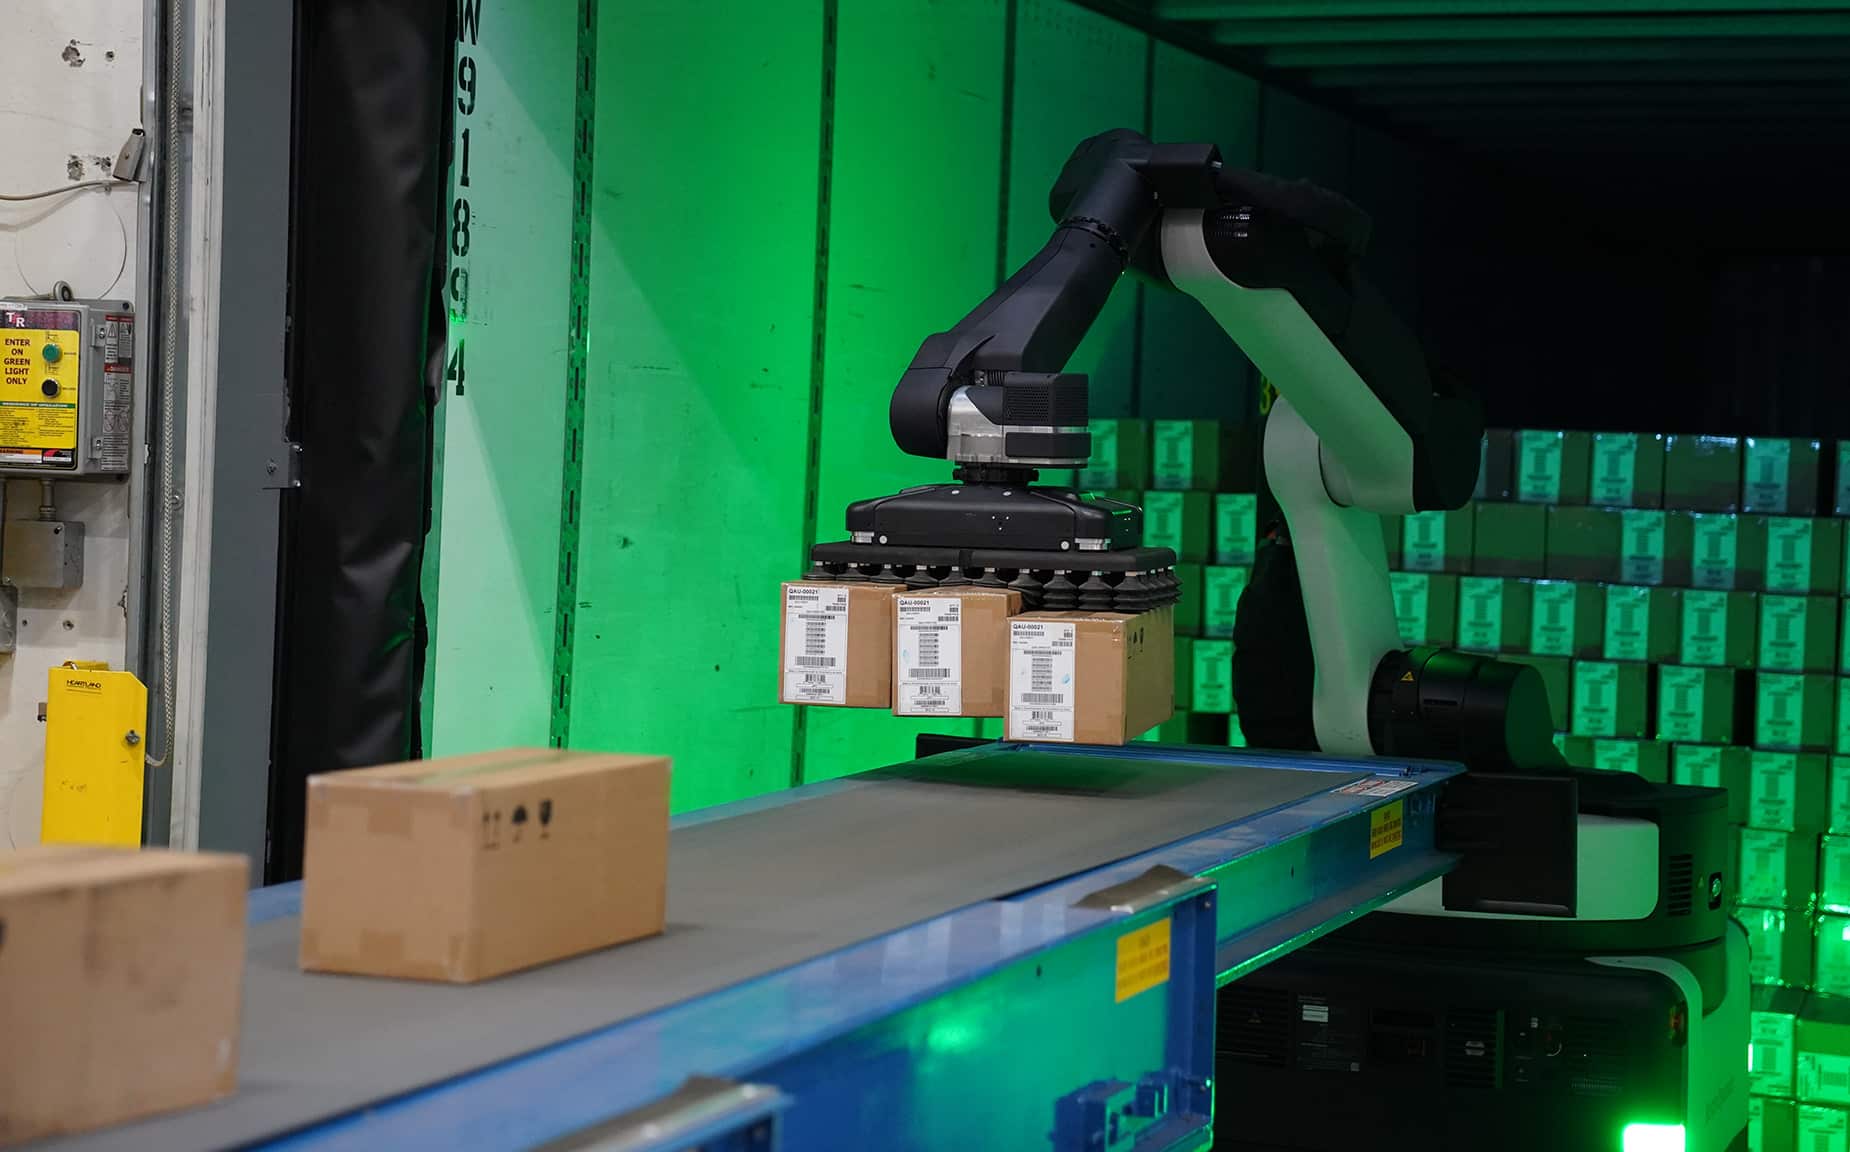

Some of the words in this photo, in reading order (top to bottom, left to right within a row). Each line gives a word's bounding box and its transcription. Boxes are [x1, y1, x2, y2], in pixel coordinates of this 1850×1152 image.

[4, 338, 31, 346] ENTER
[3, 358, 31, 366] GREEN
[66, 679, 102, 688] HEARTLAND
